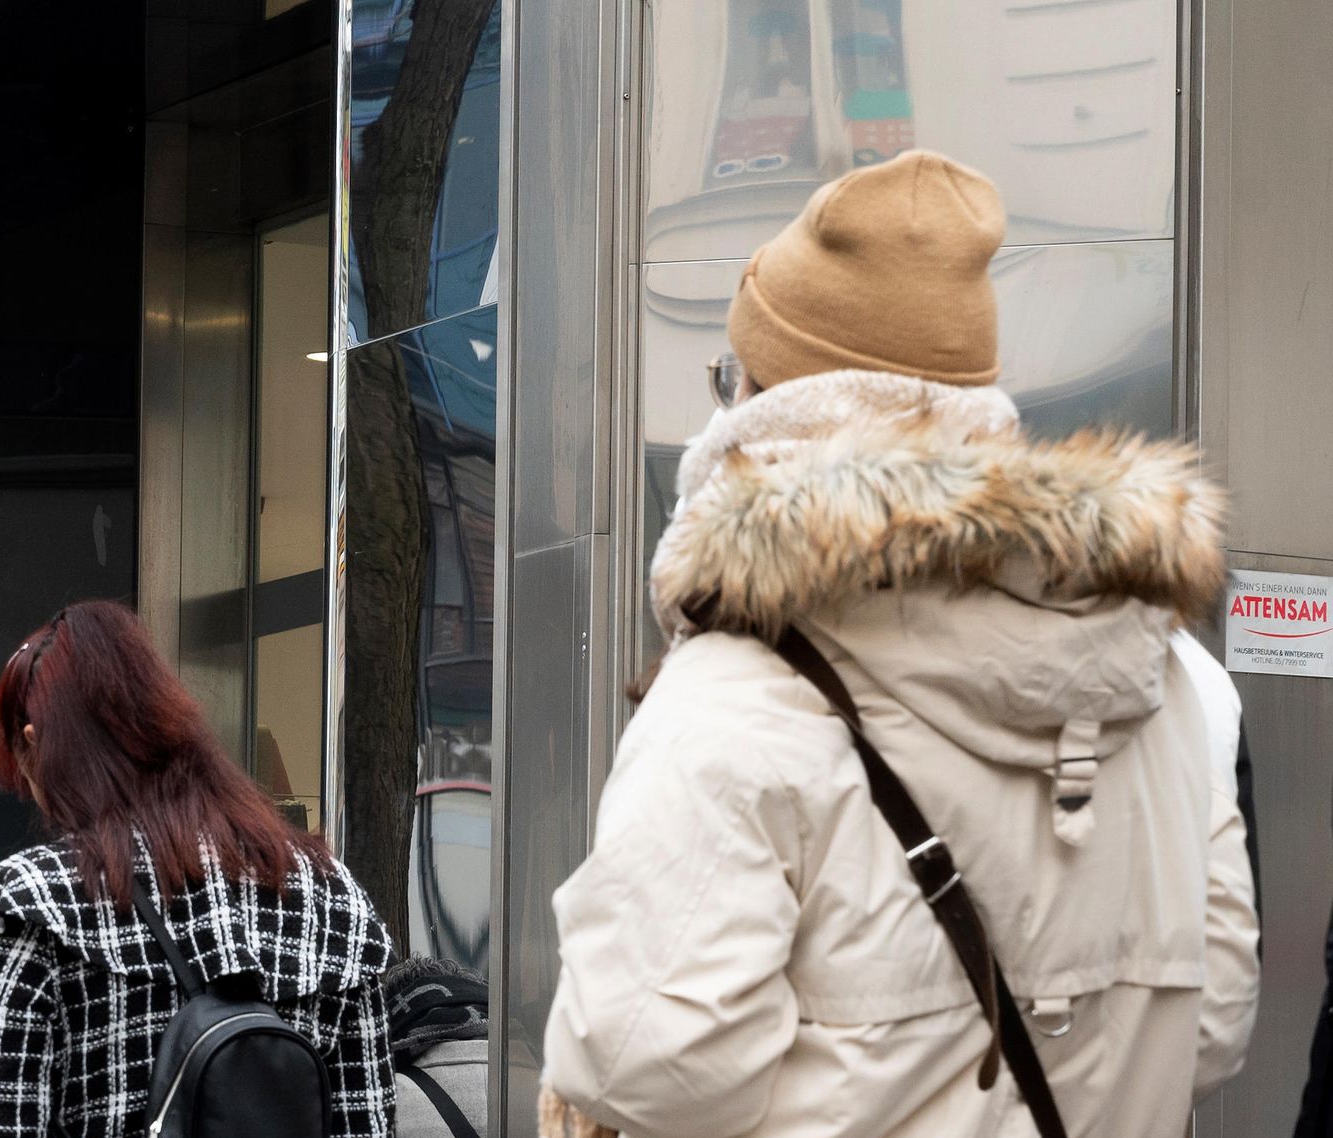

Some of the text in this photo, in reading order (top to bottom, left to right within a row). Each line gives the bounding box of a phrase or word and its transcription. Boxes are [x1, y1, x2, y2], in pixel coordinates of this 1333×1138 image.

[1262, 583, 1283, 593] EINER
[1307, 586, 1327, 596] DANN
[1230, 595, 1327, 622] ATTENSAM
[1233, 647, 1279, 657] HAUSBETREUUNG
[1284, 650, 1324, 659] WINTERSERVICE
